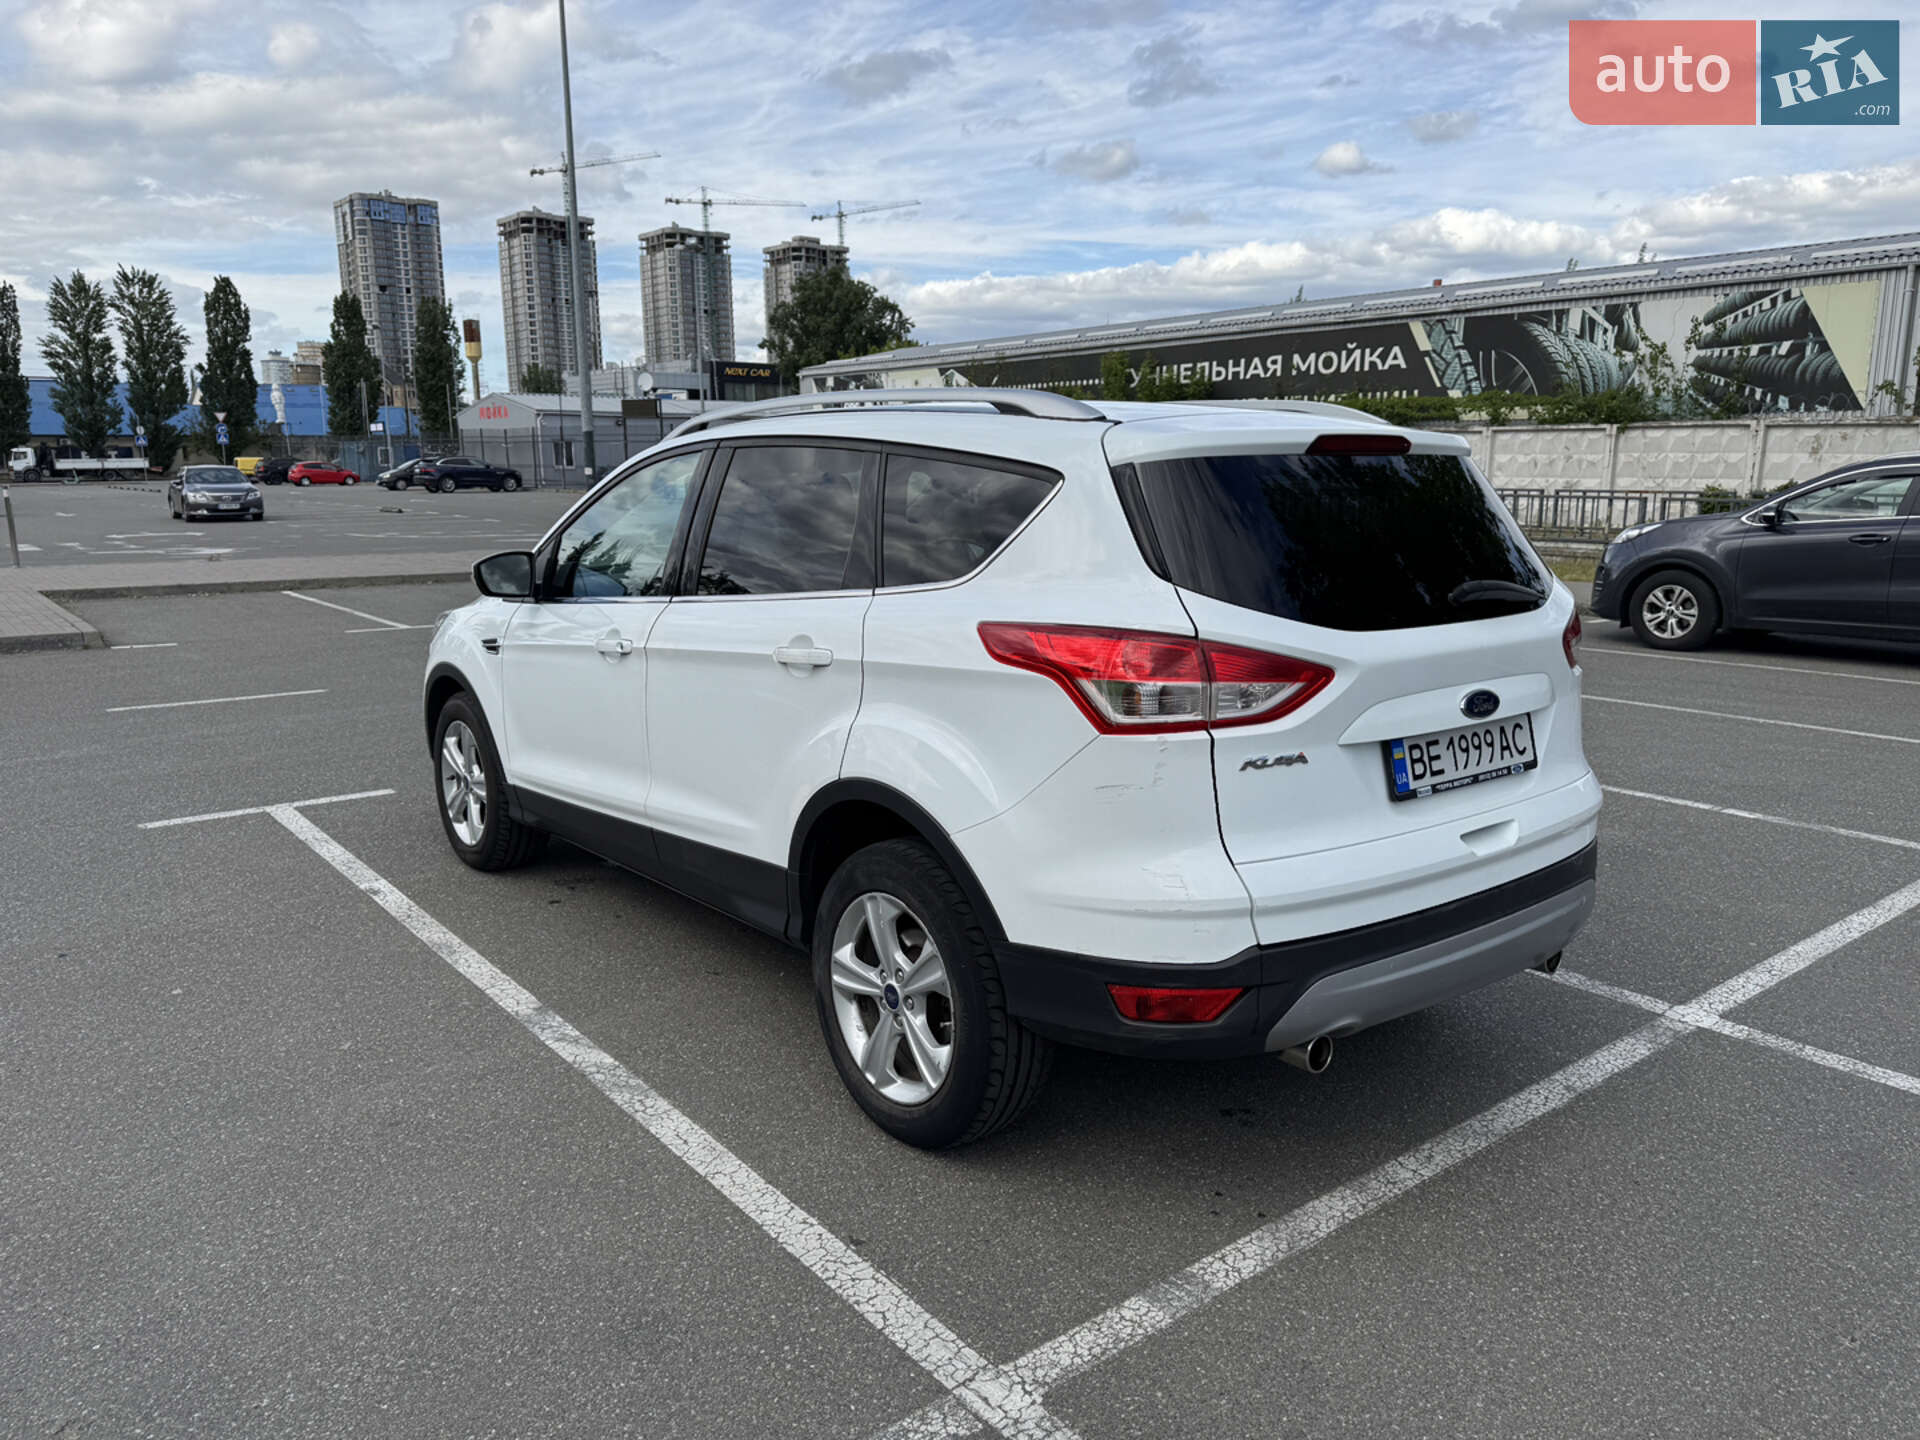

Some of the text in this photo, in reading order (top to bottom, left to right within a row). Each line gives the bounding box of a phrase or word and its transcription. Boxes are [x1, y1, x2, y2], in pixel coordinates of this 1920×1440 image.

[1291, 342, 1408, 376] МОЙКА
[750, 368, 772, 377] CAR
[479, 402, 510, 420] МОЙКА
[1396, 772, 1408, 785] UA
